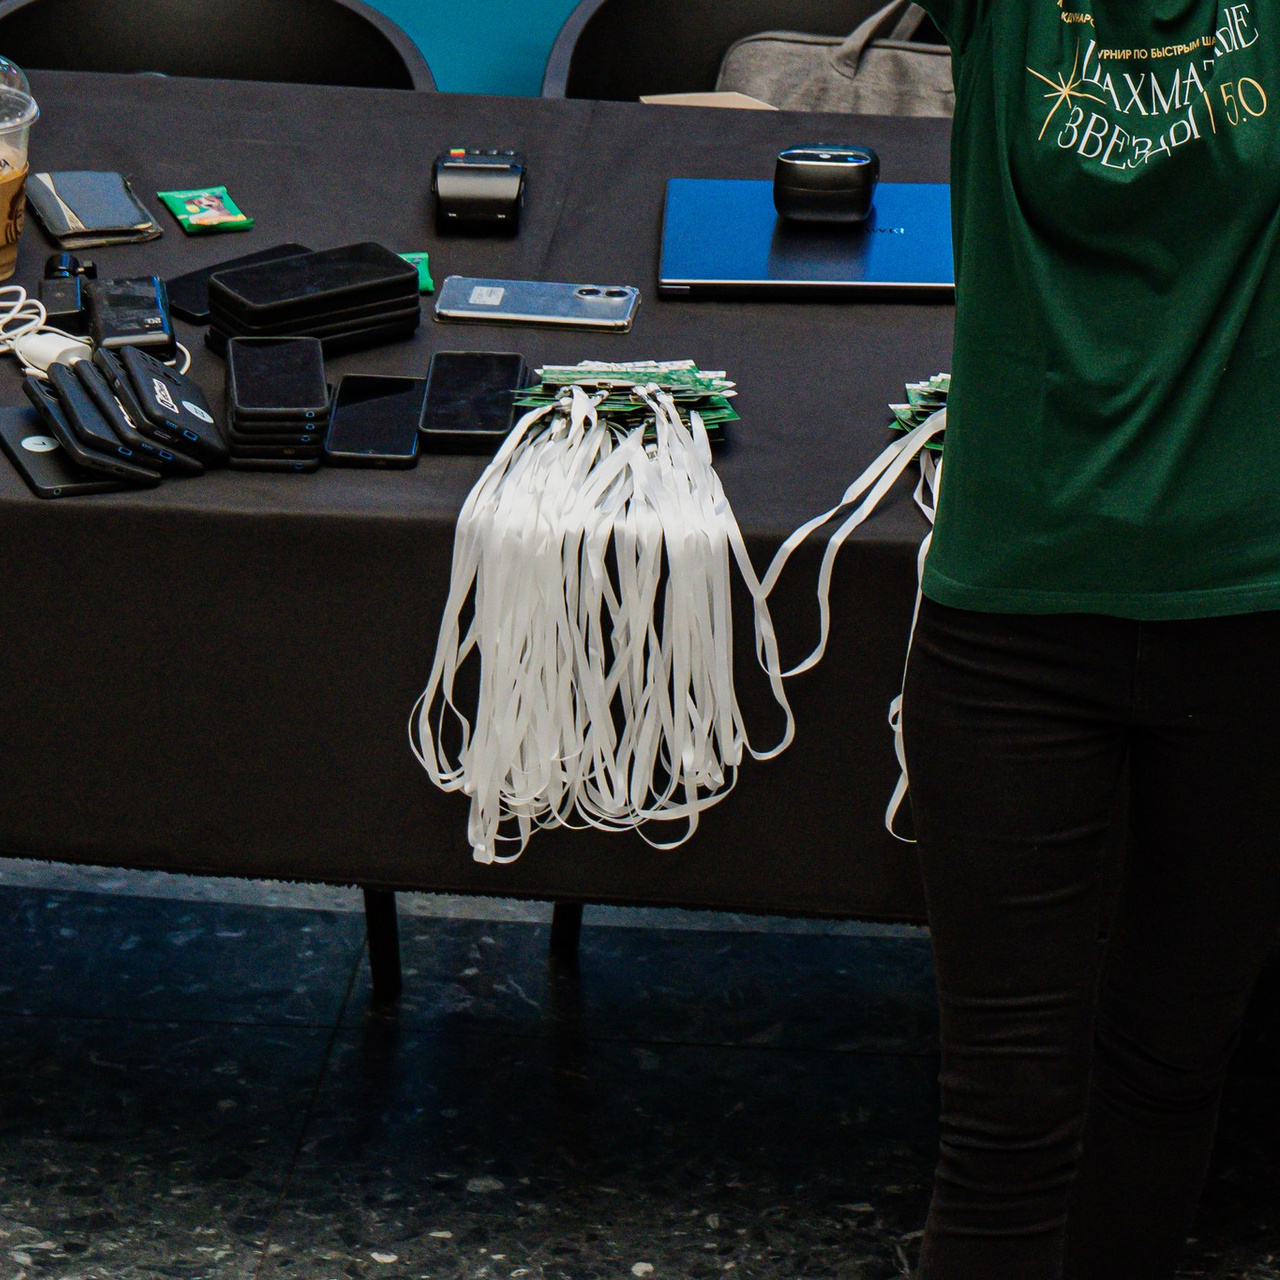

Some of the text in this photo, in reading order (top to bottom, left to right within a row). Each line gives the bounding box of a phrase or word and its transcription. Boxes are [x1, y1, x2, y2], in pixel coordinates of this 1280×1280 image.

[1133, 48, 1148, 60] ПО
[1150, 39, 1200, 58] БЫСТРЫМ
[1220, 76, 1267, 126] 5.0
